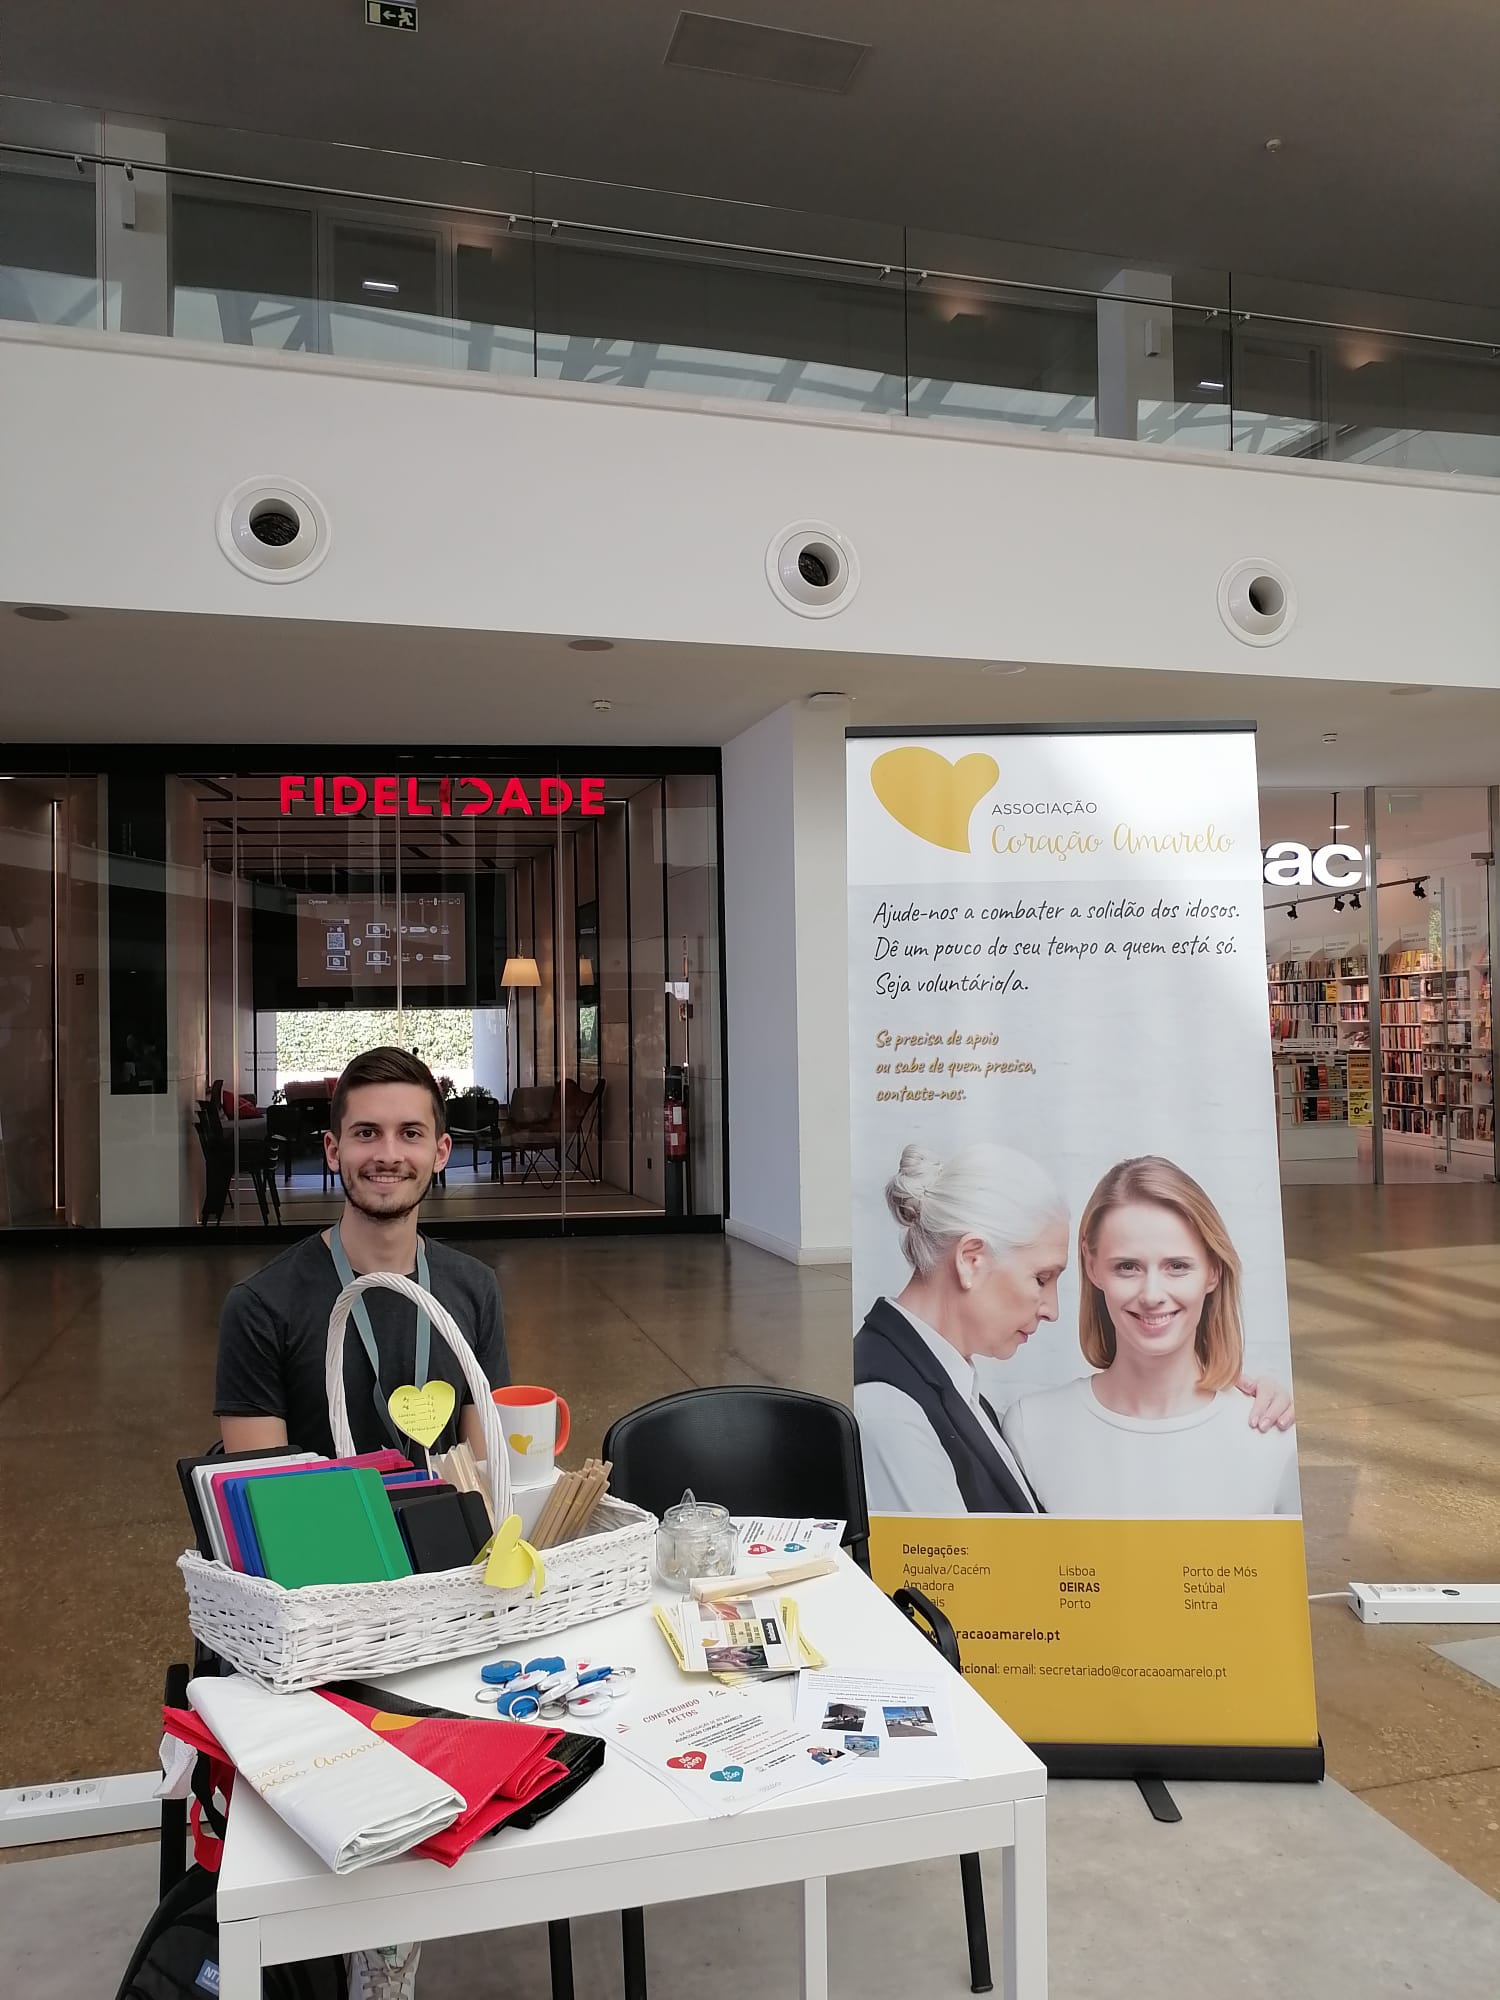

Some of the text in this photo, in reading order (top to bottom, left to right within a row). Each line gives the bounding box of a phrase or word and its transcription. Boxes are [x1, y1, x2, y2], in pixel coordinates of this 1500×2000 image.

[279, 775, 607, 816] FIDELIDADE
[991, 800, 1098, 815] ASSOCIAÇÃO
[991, 823, 1236, 861] Coração Amarelo
[1263, 841, 1363, 888] ac
[872, 898, 1241, 928] Ajude-nos a combater a solidão dos idosos.
[874, 935, 1238, 961] Dê um pouco do seu tempo a quem está só.
[875, 969, 1029, 999] Seja voluntário/a.
[875, 1029, 999, 1051] Se precisa de apoio
[875, 1056, 1037, 1078] ou sabe de quem precisa,
[875, 1086, 967, 1102] contacte-nos.
[902, 1543, 970, 1559] Delegações:
[903, 1563, 992, 1577] Agualva/Cacém
[1058, 1564, 1096, 1577] Lisboa
[1182, 1565, 1258, 1578] Porto de Mós
[903, 1580, 955, 1591] Amadora
[1059, 1582, 1101, 1593] OEIRAS
[1183, 1582, 1226, 1594] Setúbal
[1059, 1598, 1091, 1609] Porto
[1184, 1598, 1218, 1610] Sintra
[956, 1628, 1061, 1642] racaoamarelo.pt
[959, 1662, 1228, 1680] acional: email: secretariado@coracaoamarelo.pt
[642, 1698, 700, 1724] CONSTRUINDO
[667, 1709, 699, 1725] AFETOS
[313, 1740, 384, 1769] Amare
